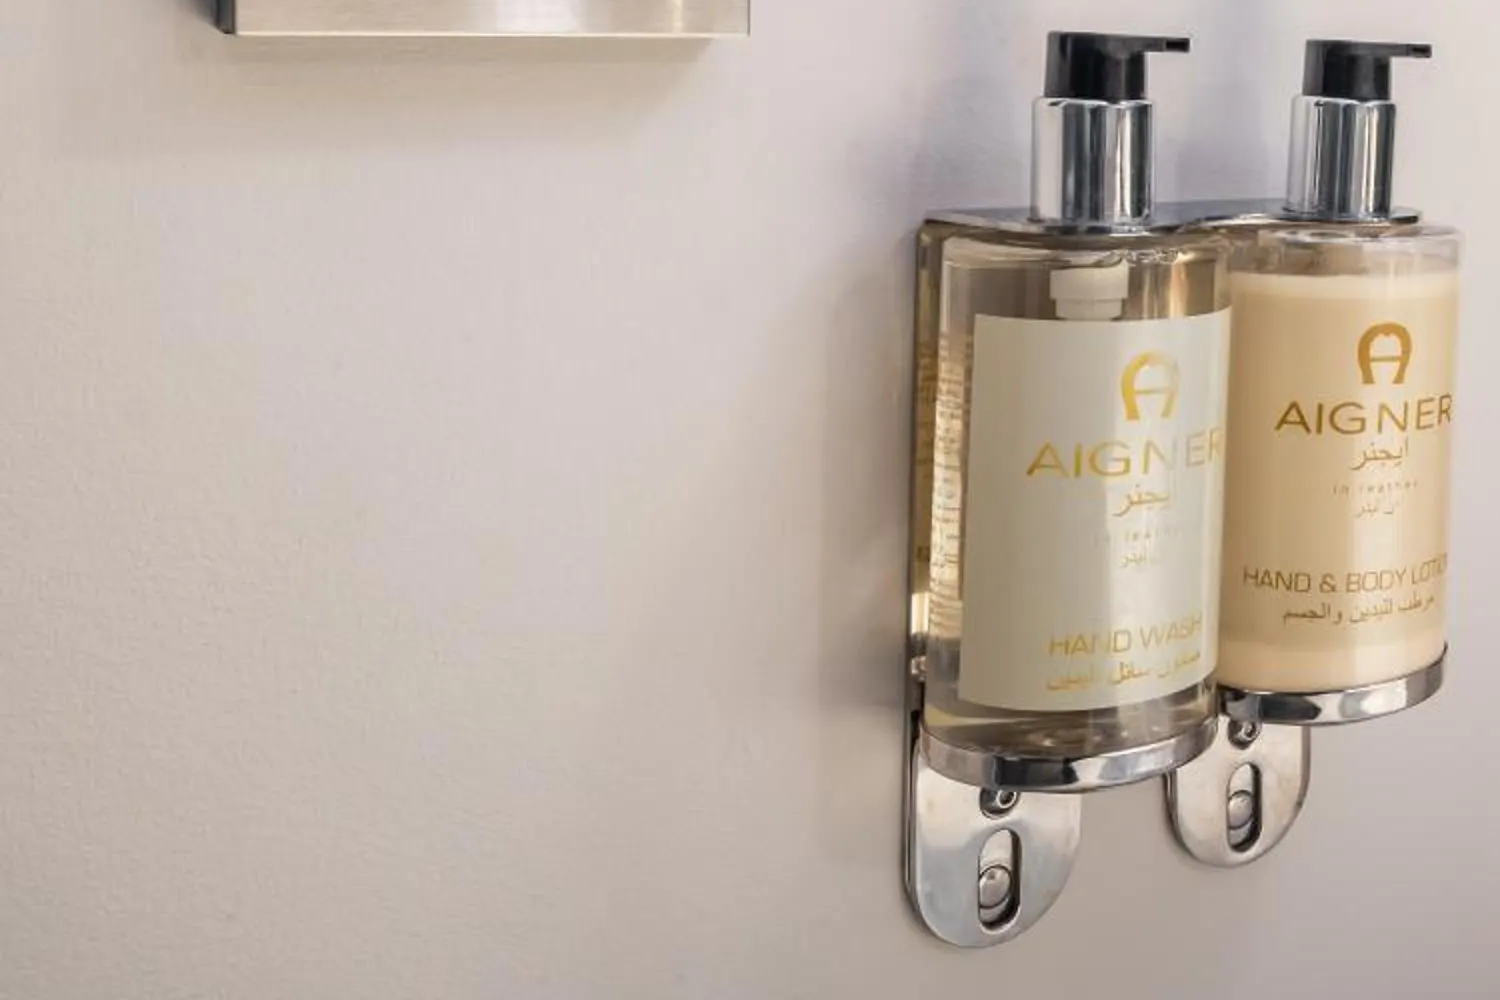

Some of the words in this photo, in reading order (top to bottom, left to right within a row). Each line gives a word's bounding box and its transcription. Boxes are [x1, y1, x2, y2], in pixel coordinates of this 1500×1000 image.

[1274, 394, 1452, 435] AIGNER
[1026, 426, 1223, 479] AIGNER
[1243, 566, 1311, 593] HAND
[1319, 572, 1337, 594] &
[1346, 568, 1406, 593] BODY
[1048, 629, 1132, 656] HAND
[1139, 611, 1203, 649] WASH
